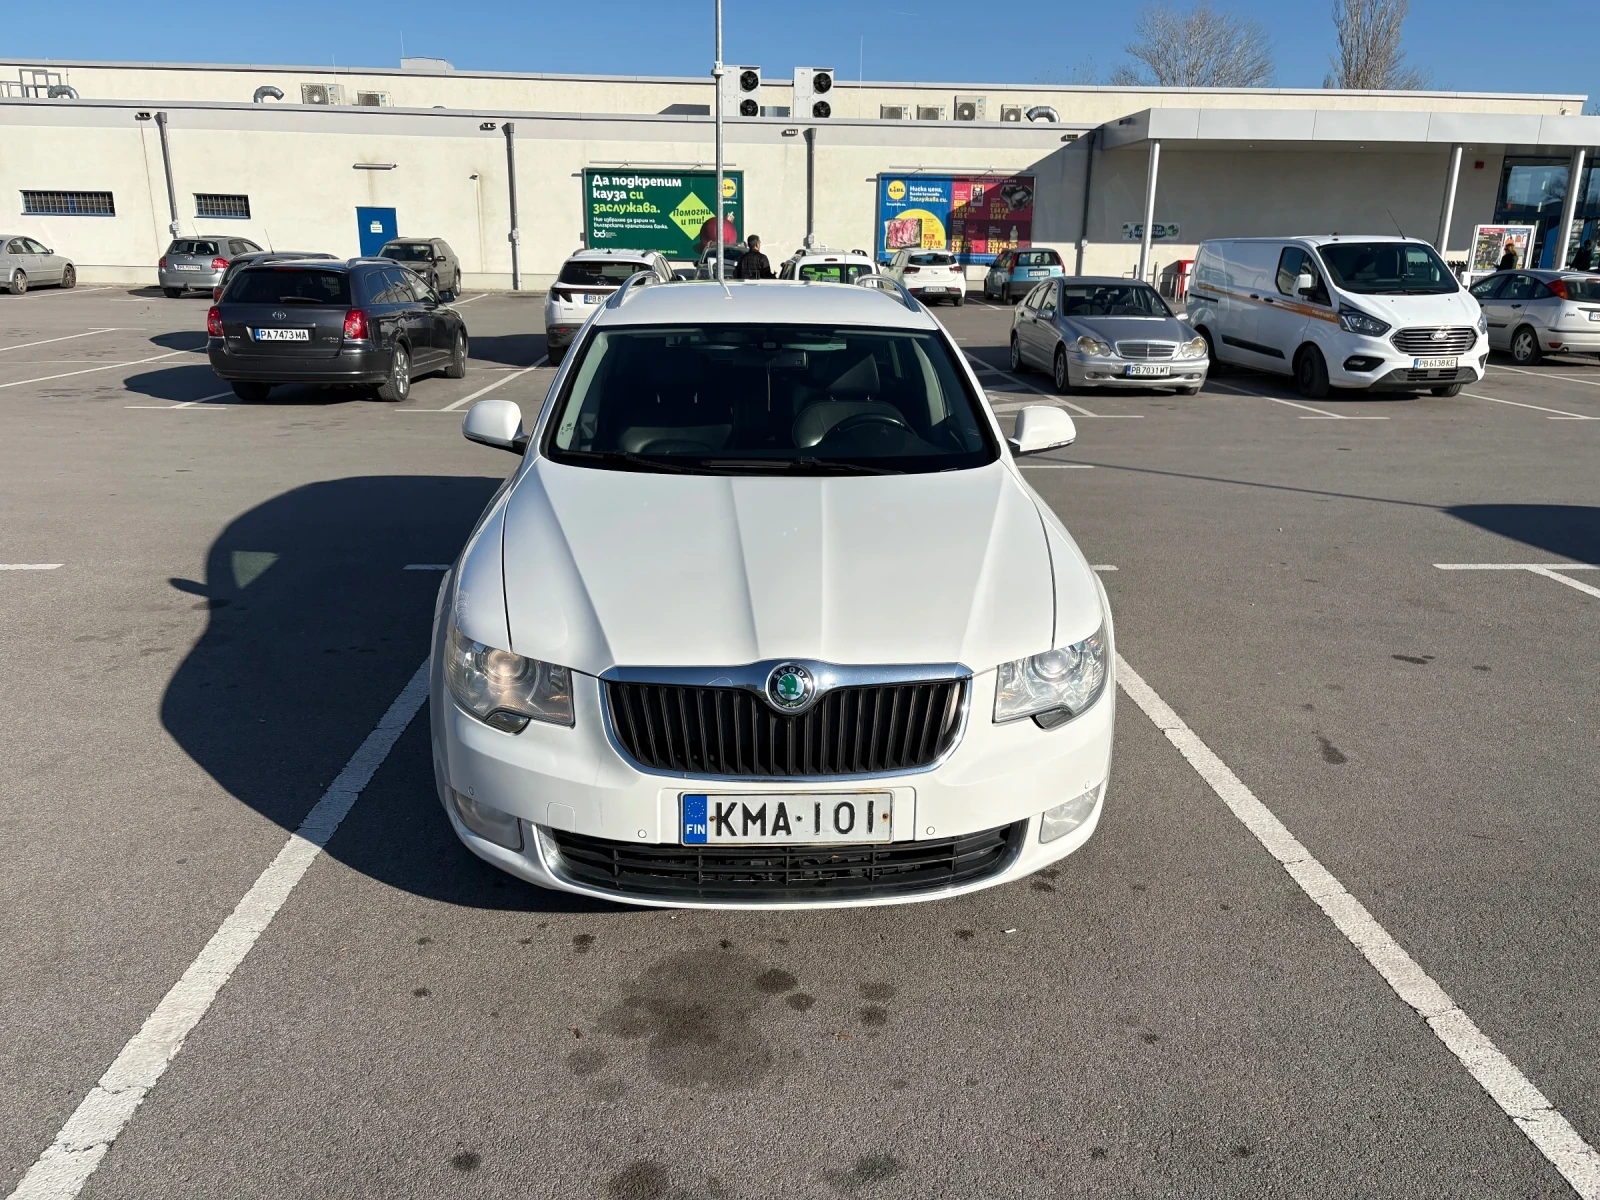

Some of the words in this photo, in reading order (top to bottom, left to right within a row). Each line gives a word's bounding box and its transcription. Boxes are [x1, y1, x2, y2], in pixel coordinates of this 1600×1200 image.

[592, 175, 610, 187] Да
[612, 175, 682, 189] подкрепим
[592, 188, 627, 201] кауза
[629, 191, 644, 200] си
[593, 202, 661, 215] заслужава.
[673, 208, 711, 217] Помогни
[686, 824, 706, 835] FIN
